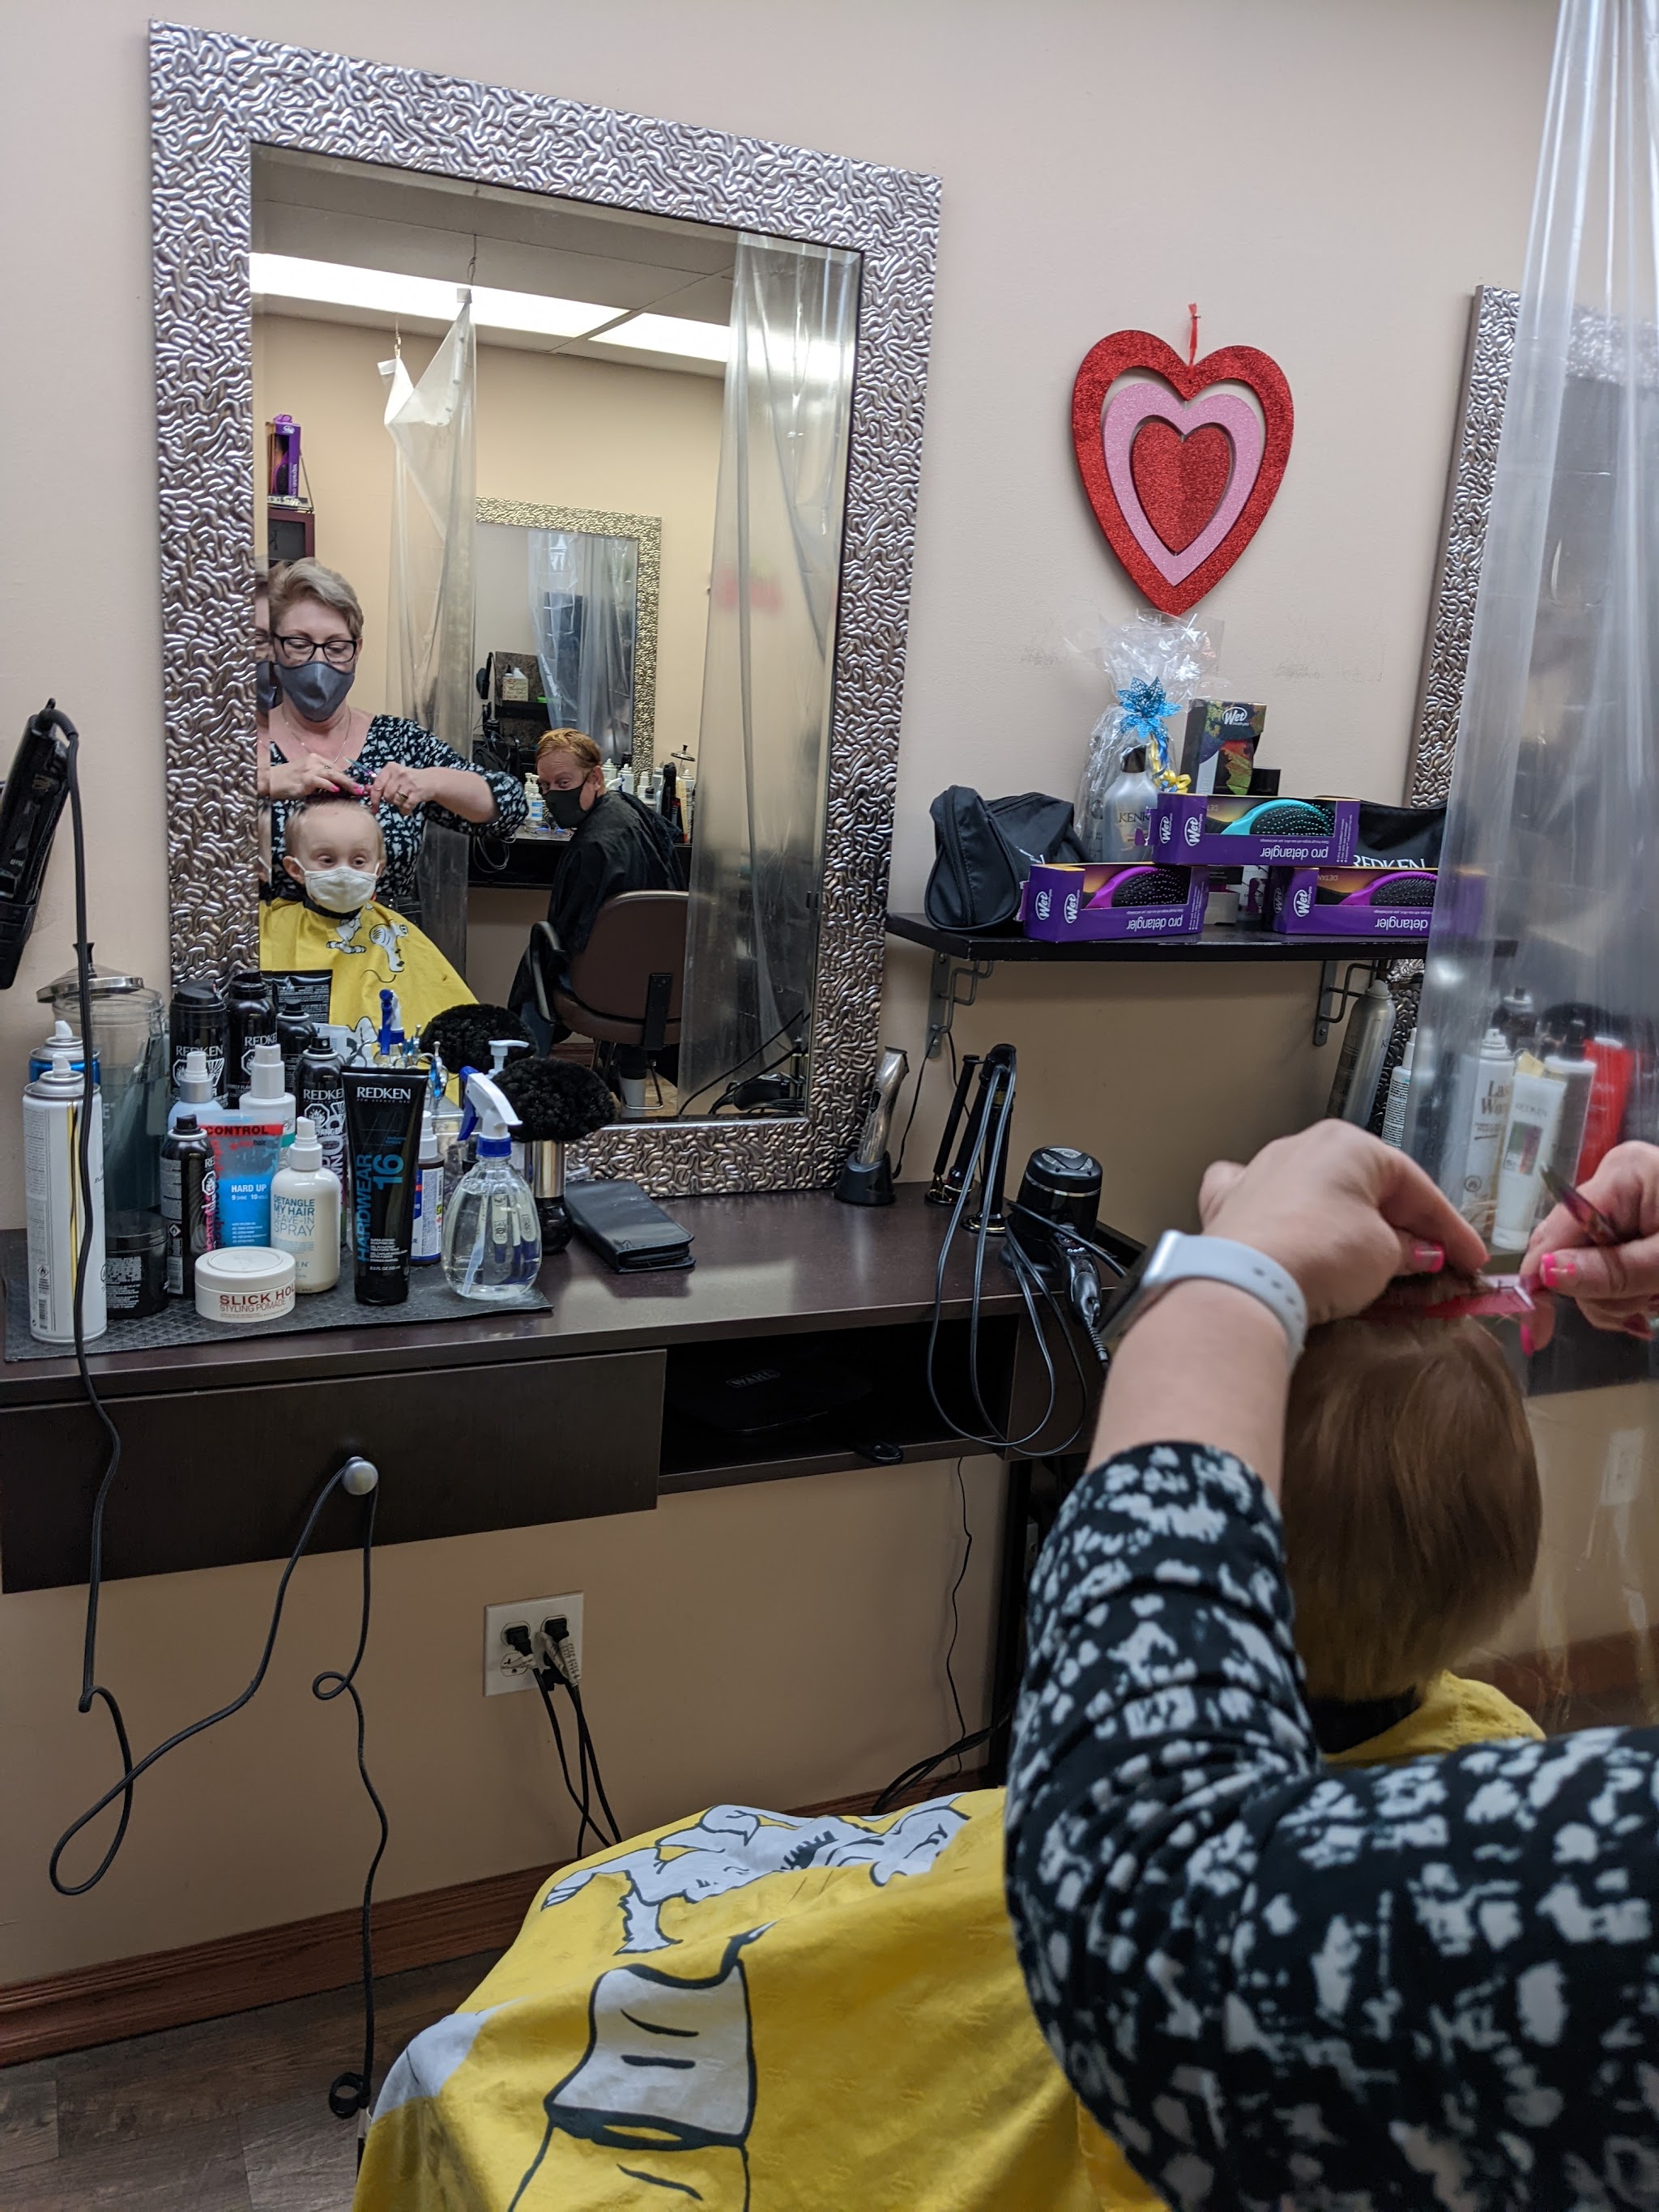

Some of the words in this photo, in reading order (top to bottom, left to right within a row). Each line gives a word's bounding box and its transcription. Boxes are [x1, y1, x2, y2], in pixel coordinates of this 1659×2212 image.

[1223, 709, 1246, 726] Wet
[1161, 818, 1171, 841] Wet
[1187, 820, 1201, 842] Wet
[1260, 846, 1309, 860] detangler
[1311, 846, 1329, 859] pro
[1038, 894, 1050, 918] Wet
[1067, 896, 1078, 920] Wet
[1296, 893, 1310, 914] Wet
[1126, 916, 1166, 931] detangler
[1168, 914, 1183, 927] pro
[1375, 915, 1428, 931] detangler
[356, 1086, 412, 1100] REDKEN
[207, 1125, 269, 1135] CONTROL
[373, 1153, 404, 1190] 16
[231, 1184, 254, 1193] HARD
[256, 1183, 267, 1192] UP
[274, 1195, 315, 1208] DETANGLE
[356, 1154, 372, 1263] HARDWEAR
[274, 1203, 286, 1213] MY
[288, 1207, 315, 1217] HAIR
[275, 1213, 314, 1225] LEAVE-IN
[275, 1220, 315, 1237] SPRAY
[220, 1292, 271, 1306] SLICK
[220, 1303, 255, 1313] STYLING
[255, 1298, 286, 1311] POMADE
